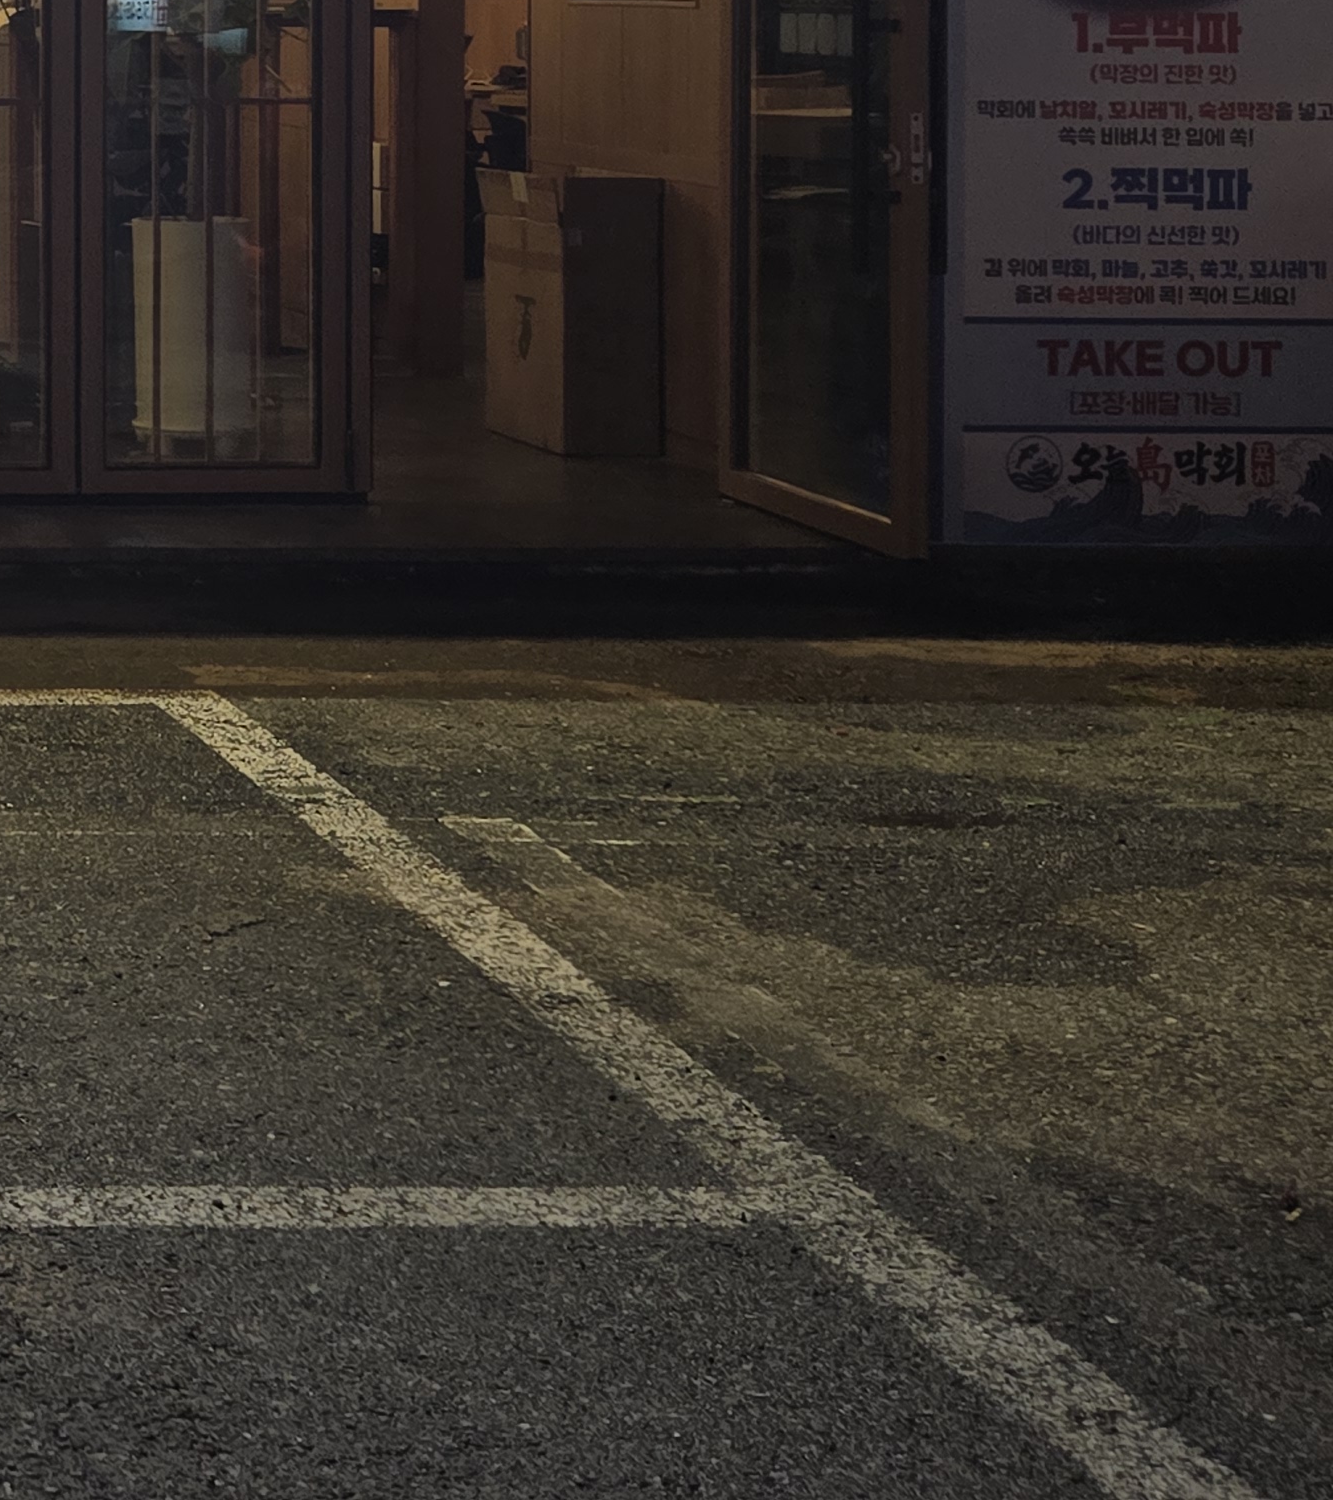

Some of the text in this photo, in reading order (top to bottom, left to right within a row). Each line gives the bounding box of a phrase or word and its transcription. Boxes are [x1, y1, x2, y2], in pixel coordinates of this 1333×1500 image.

[1165, 63, 1203, 85] 진한
[1162, 127, 1181, 147] 한
[1186, 127, 1226, 147] 입에
[1062, 167, 1252, 211] 2.찍먹파
[1147, 225, 1205, 247] 신선한
[1007, 258, 1047, 277] 위에
[1037, 339, 1282, 378] TAKE OUT
[1068, 436, 1247, 494] 오늘島막회
